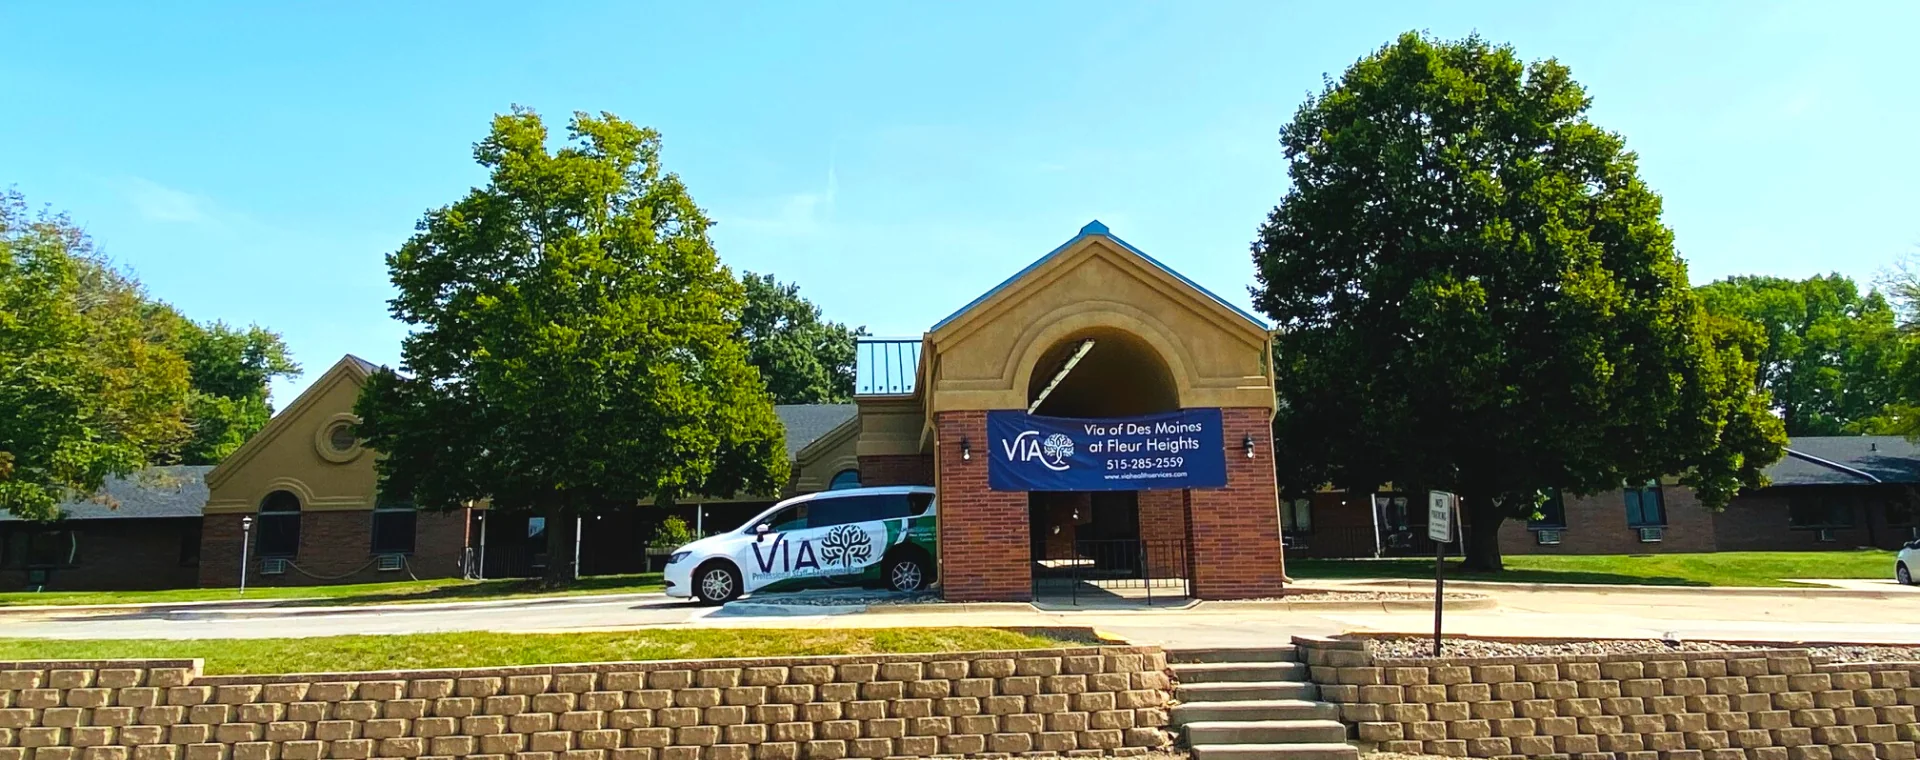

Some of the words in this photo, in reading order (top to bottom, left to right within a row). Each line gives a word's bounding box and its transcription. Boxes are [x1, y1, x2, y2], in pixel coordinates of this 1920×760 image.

[1084, 424, 1105, 436] Via
[1109, 423, 1124, 436] of
[1127, 423, 1152, 436] Des
[1155, 421, 1202, 434] Moines
[1089, 441, 1104, 453] at
[1107, 439, 1143, 453] Fleur
[1146, 436, 1200, 454] Heights
[1106, 457, 1184, 470] 515-285-2559
[751, 532, 821, 573] VIA
[752, 569, 791, 580] Professional
